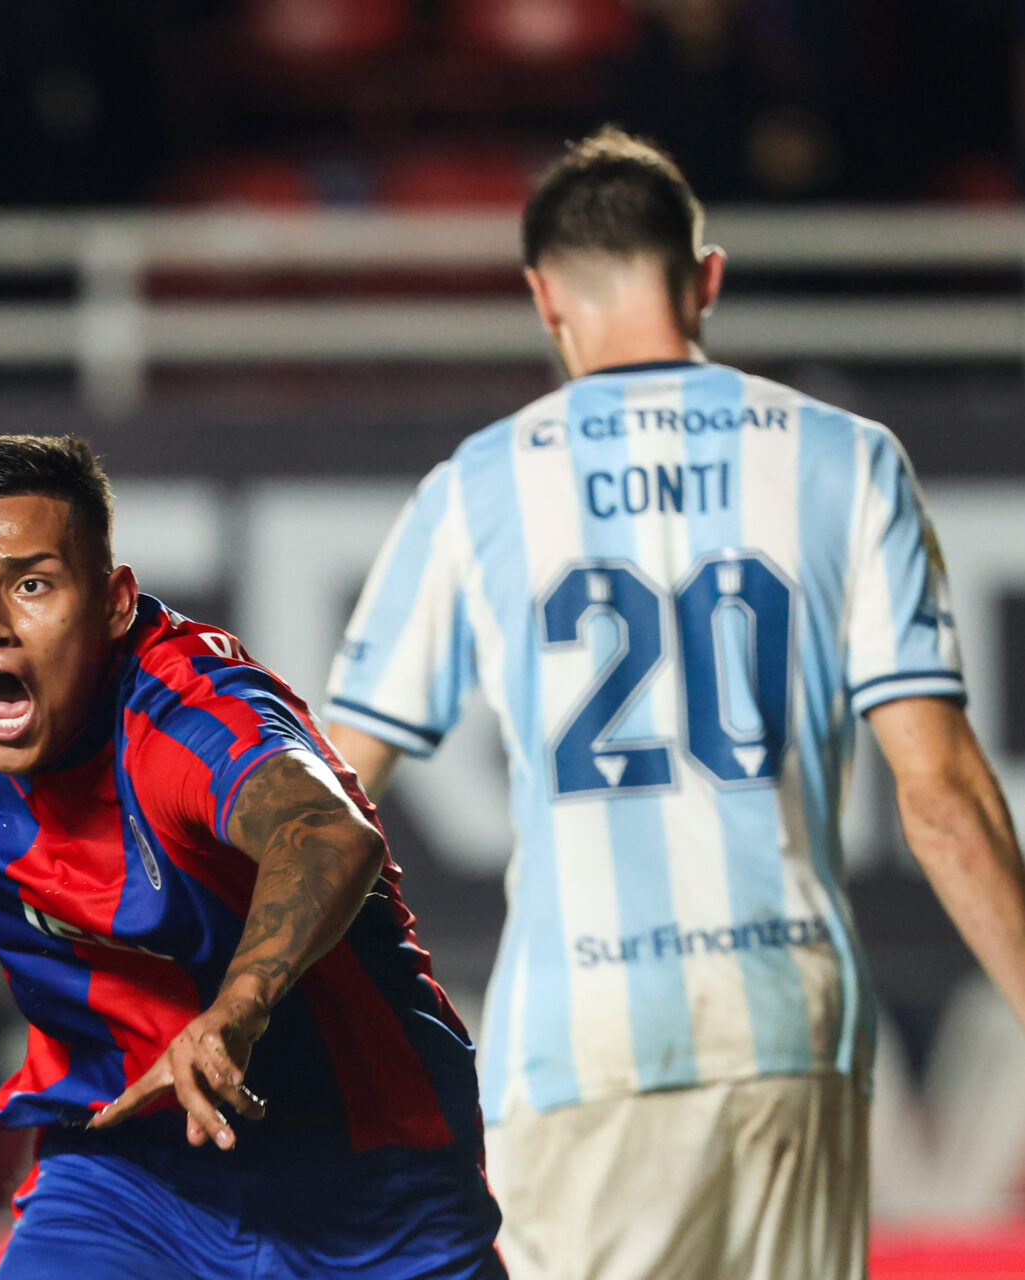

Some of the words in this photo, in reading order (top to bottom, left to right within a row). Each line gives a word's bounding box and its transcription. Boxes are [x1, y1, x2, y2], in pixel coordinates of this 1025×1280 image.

[581, 407, 789, 441] CETROGAR
[586, 462, 729, 520] CONTI
[535, 548, 801, 802] 20
